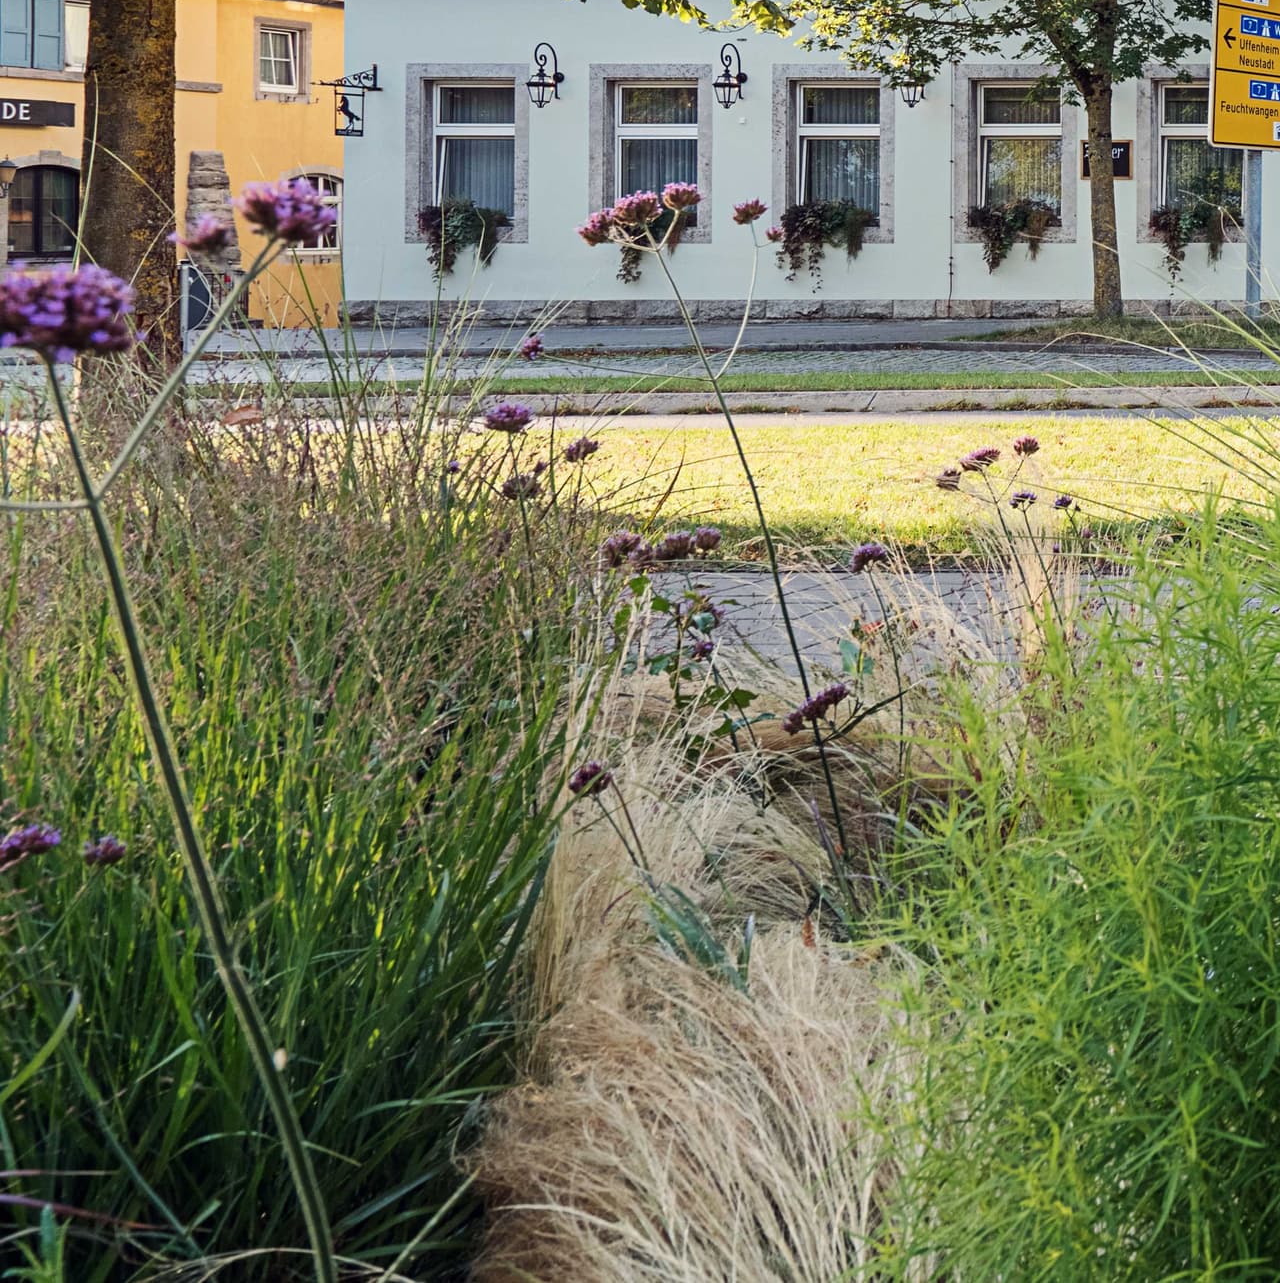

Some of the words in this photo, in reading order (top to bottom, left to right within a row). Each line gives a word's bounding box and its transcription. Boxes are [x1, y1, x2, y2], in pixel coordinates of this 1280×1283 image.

[1239, 38, 1280, 55] Uffenheim
[1239, 55, 1274, 69] Neustadt
[1220, 101, 1279, 119] Feuchtwangen
